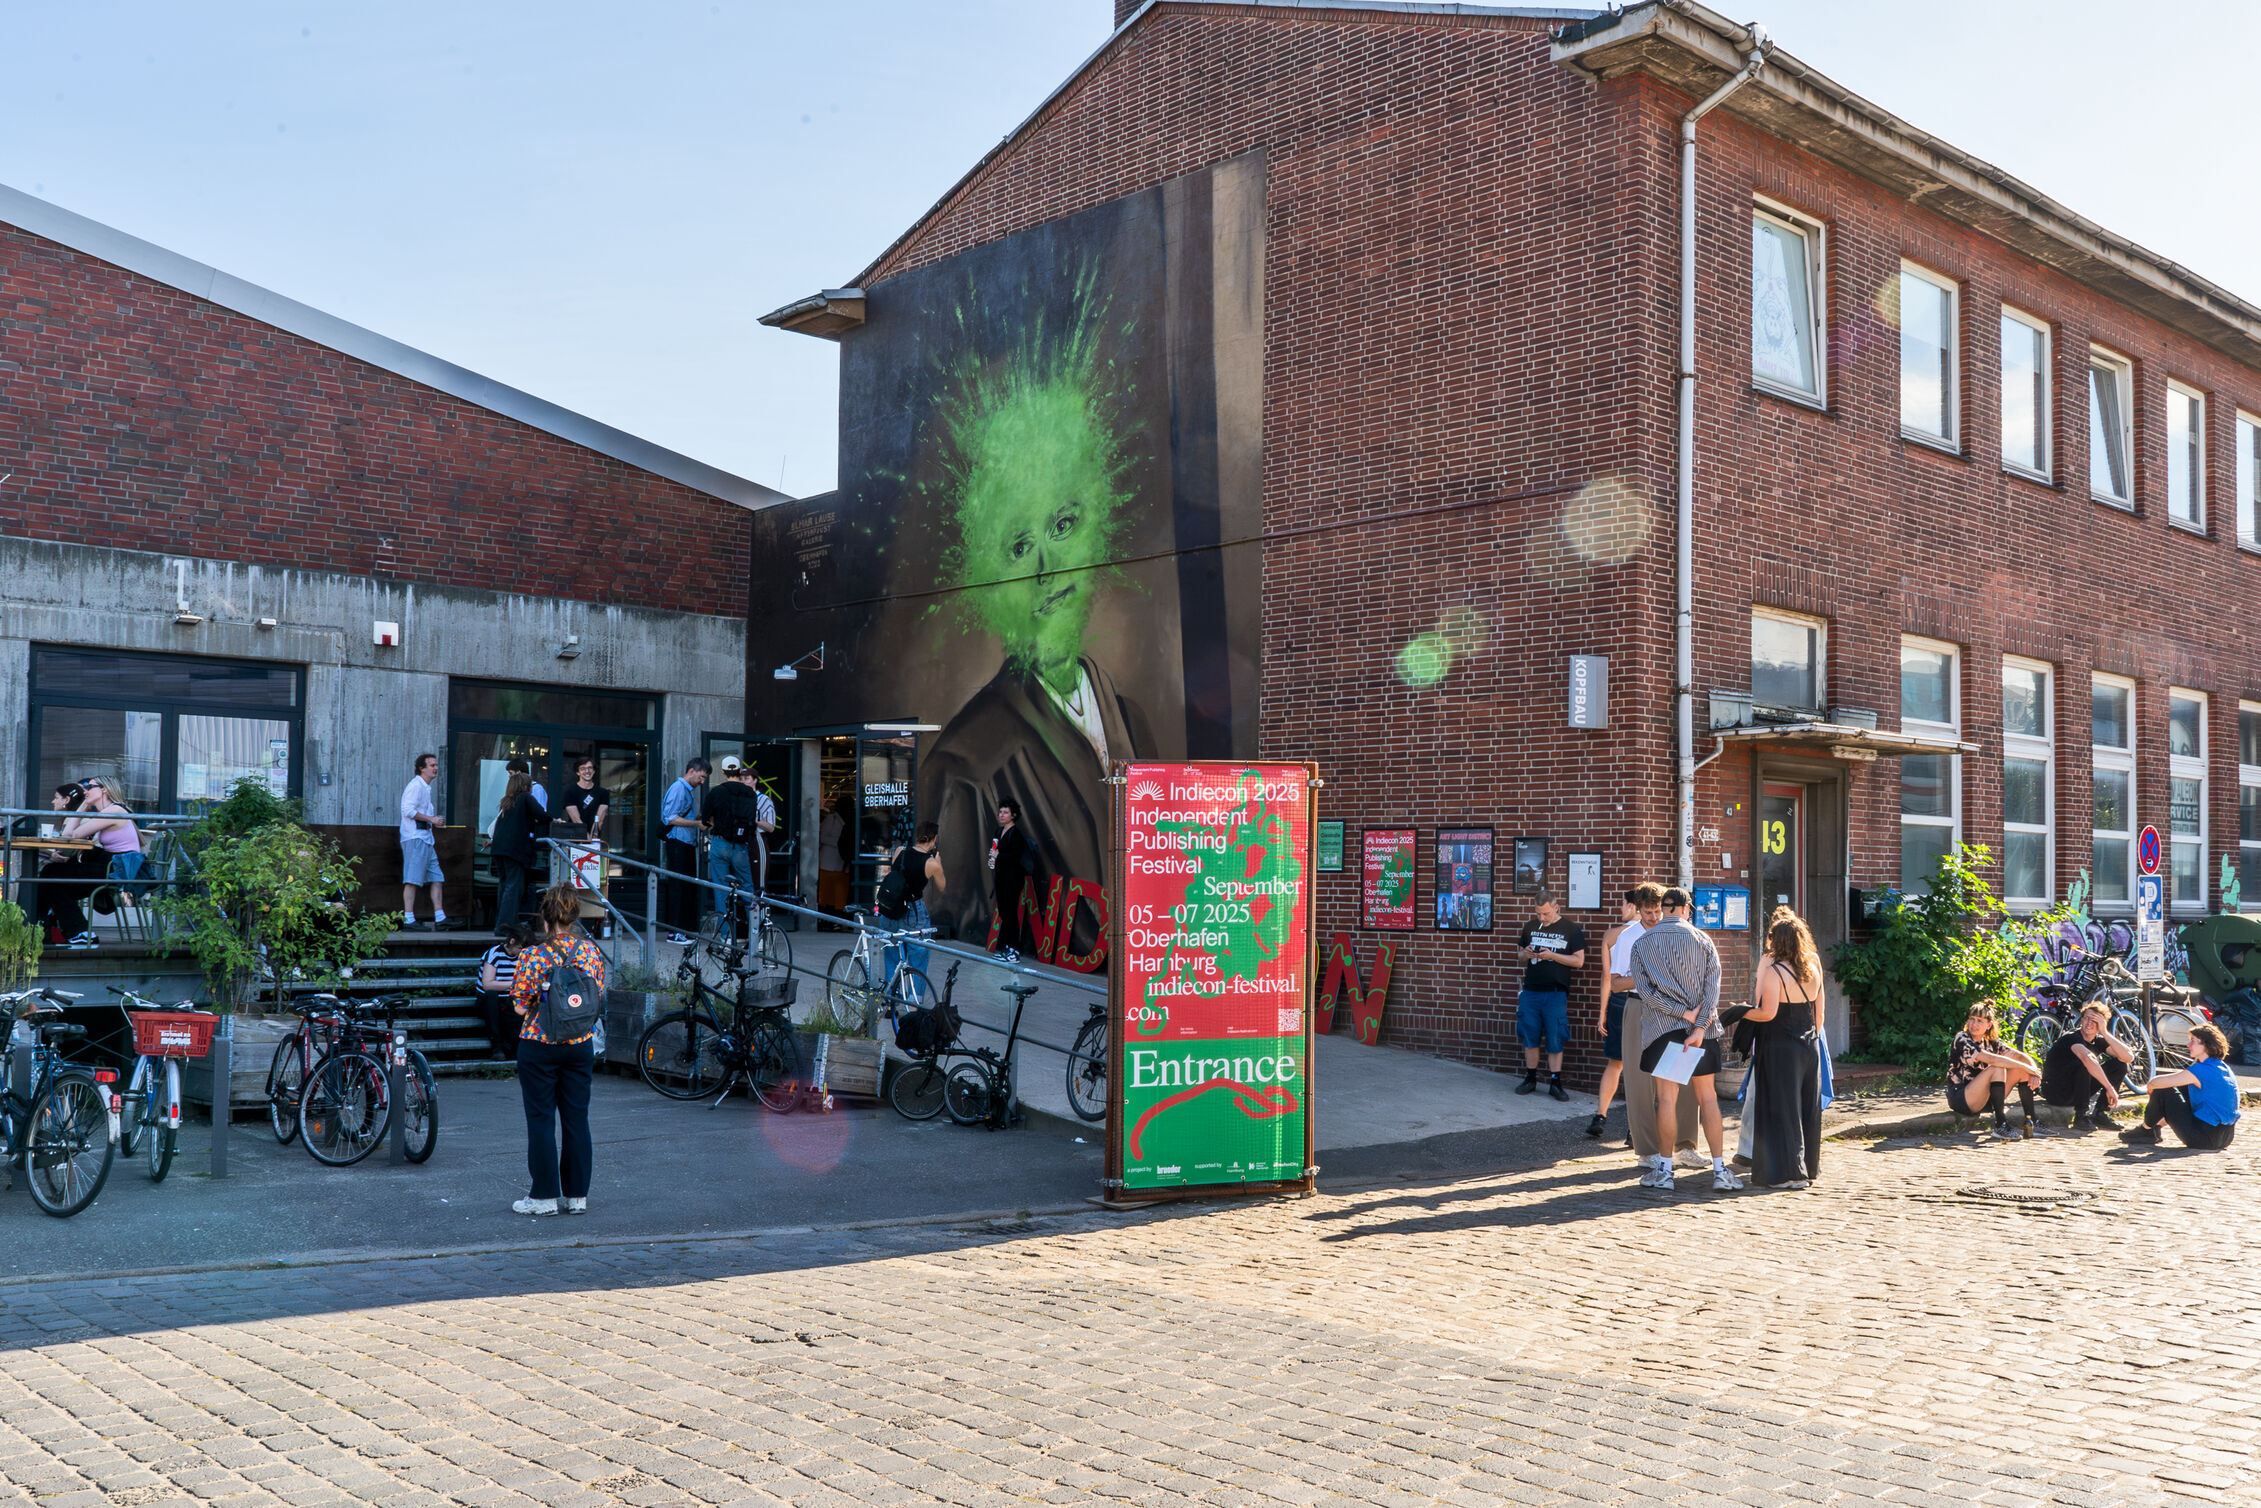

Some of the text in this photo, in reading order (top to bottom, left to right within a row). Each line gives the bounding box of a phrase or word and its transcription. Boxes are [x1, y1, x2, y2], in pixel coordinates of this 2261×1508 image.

[1574, 659, 1587, 724] KOPFBAU
[864, 781, 909, 795] GLEISHALLE
[1170, 782, 1300, 801] Indiecon 2025
[864, 795, 909, 807] OBERHAFEN
[1130, 807, 1248, 826] Independent
[1130, 831, 1227, 854] Publishing
[1399, 836, 1414, 844] 2025
[1130, 855, 1202, 874] Festival
[1365, 854, 1392, 863] Publishing
[1385, 870, 1415, 879] September
[1203, 875, 1303, 901] September
[1364, 888, 1393, 896] Oberhafen
[2144, 881, 2158, 915] P
[1129, 905, 1153, 924] 05
[1174, 904, 1198, 923] 07
[1203, 904, 1250, 923] 2025
[1129, 928, 1229, 948] Oberhafen
[1129, 952, 1217, 975] Hamburg
[1147, 973, 1300, 996] indiecon-festival.
[1130, 1050, 1296, 1088] Entrance
